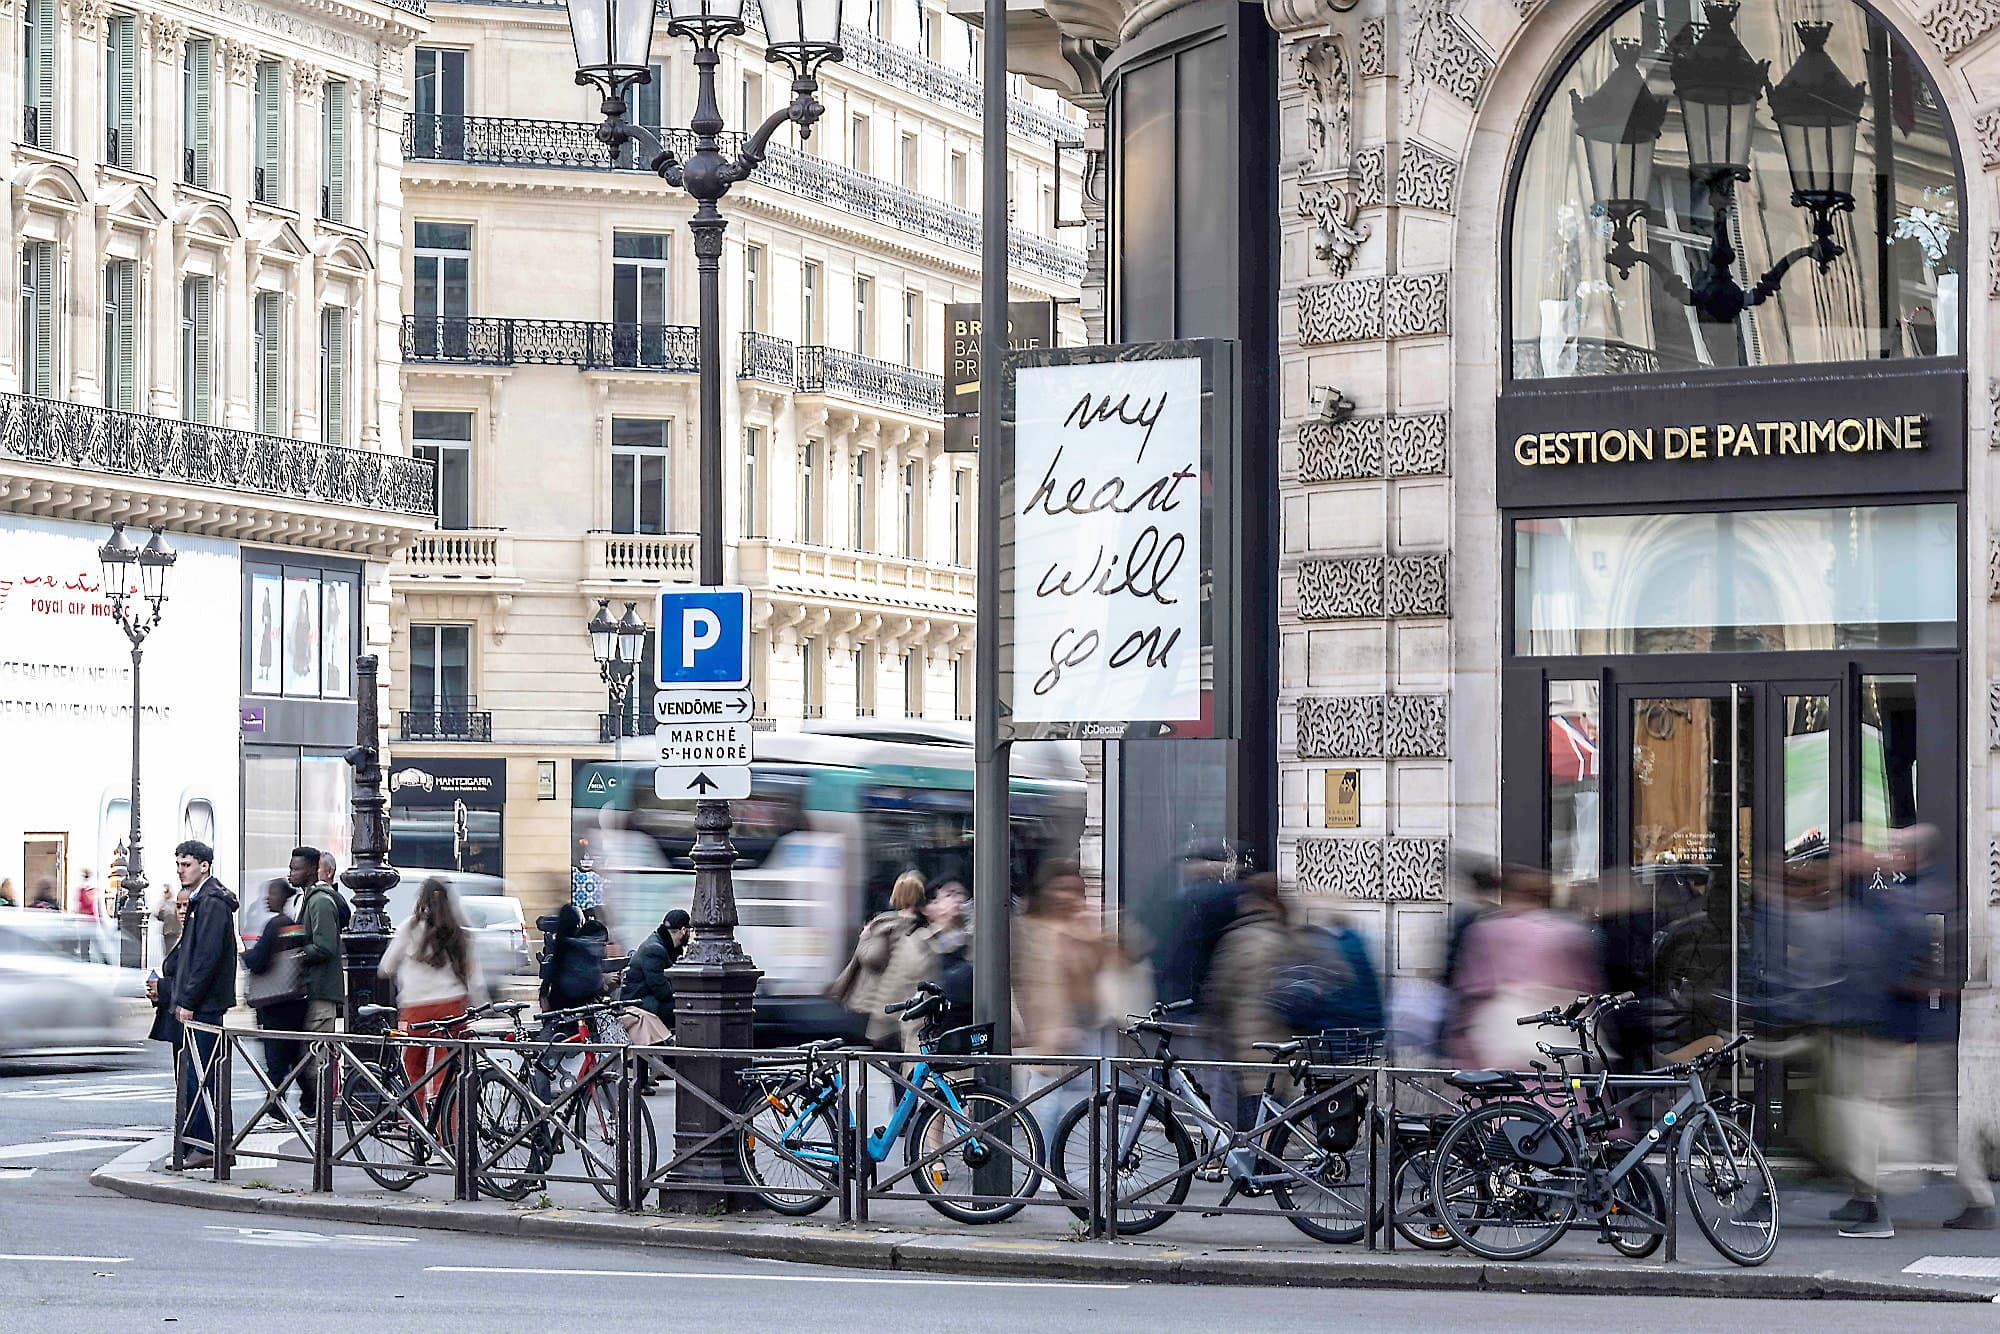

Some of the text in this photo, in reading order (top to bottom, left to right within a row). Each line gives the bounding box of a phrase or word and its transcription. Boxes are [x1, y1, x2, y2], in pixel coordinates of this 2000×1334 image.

[1063, 391, 1168, 464] my
[1514, 415, 1922, 466] GESTION DE PATRIMOINE
[1023, 445, 1197, 515] heart
[1036, 525, 1185, 605] will
[31, 599, 63, 615] royal
[68, 602, 86, 615] air
[682, 607, 722, 668] P
[1033, 626, 1182, 695] go on
[658, 698, 723, 715] VENDÔME
[671, 726, 736, 742] MARCHÉ
[1081, 724, 1125, 736] JCDecaux
